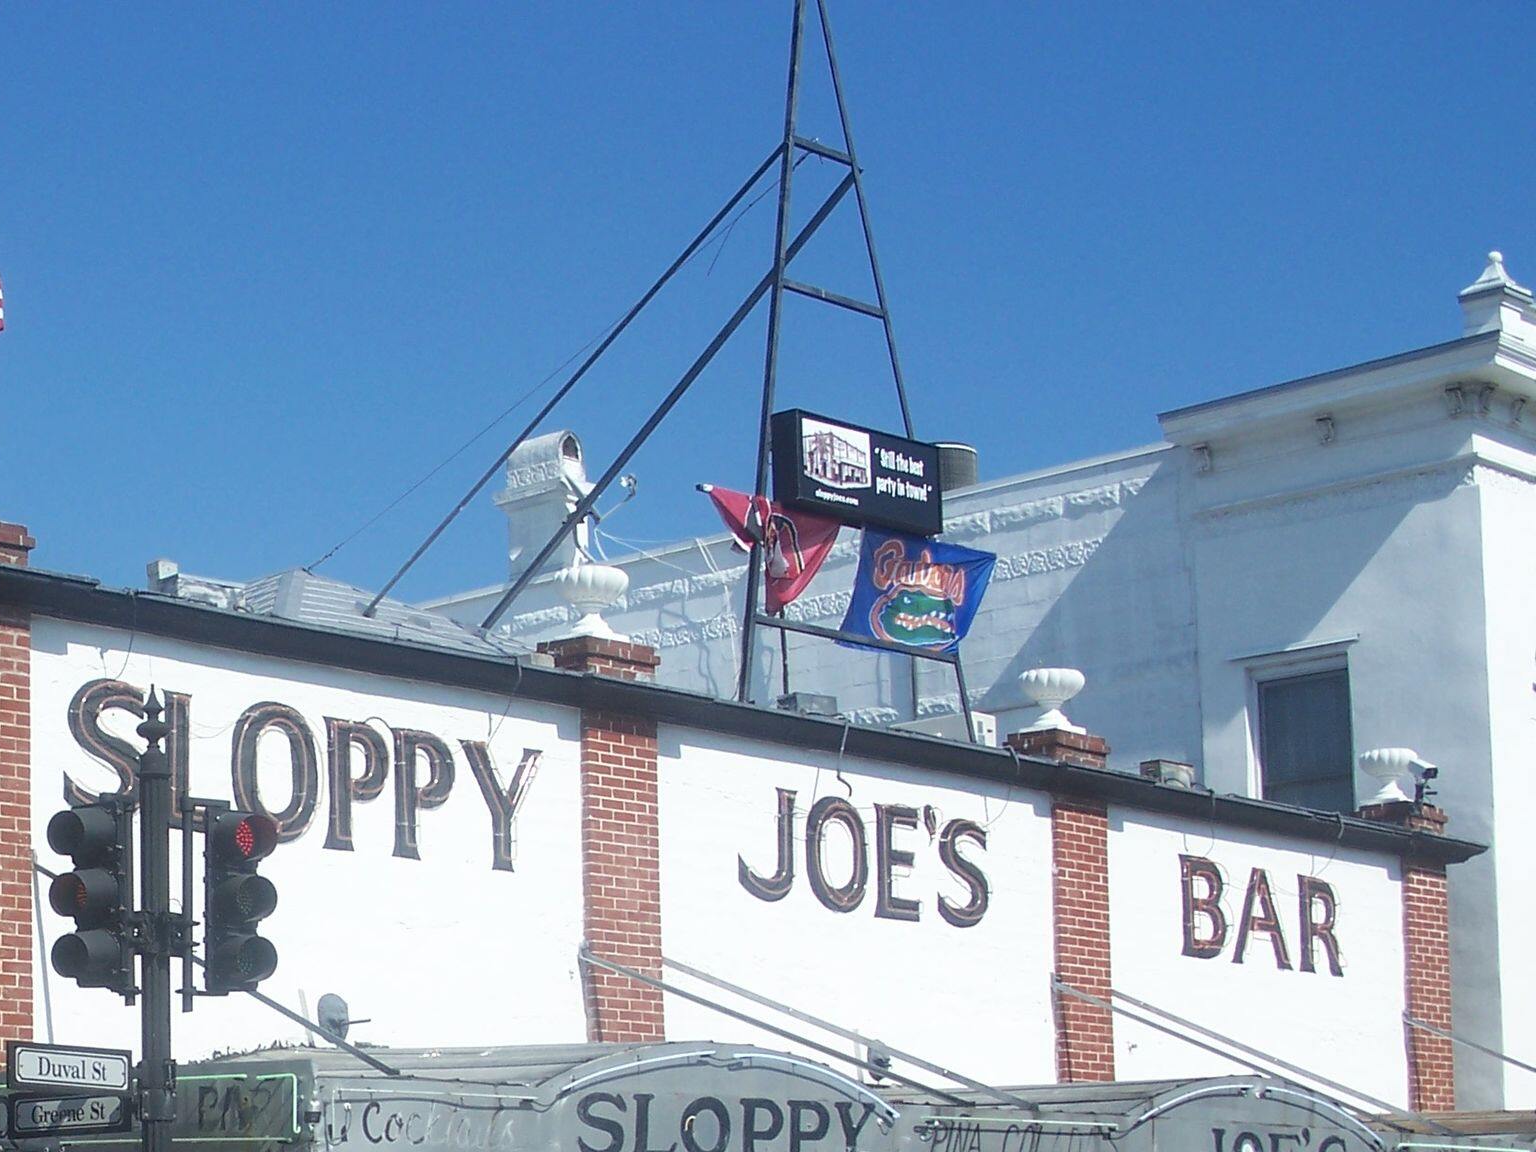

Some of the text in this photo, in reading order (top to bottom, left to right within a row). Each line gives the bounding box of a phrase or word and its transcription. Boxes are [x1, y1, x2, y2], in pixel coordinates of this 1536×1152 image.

[896, 452, 909, 474] the
[909, 456, 923, 477] best
[876, 476, 896, 498] party
[897, 478, 905, 497] in
[874, 540, 964, 606] Gators
[64, 677, 1345, 978] SLOPPY JOE'S BAR
[37, 1056, 106, 1081] Duval St
[31, 1101, 105, 1125] Greene St
